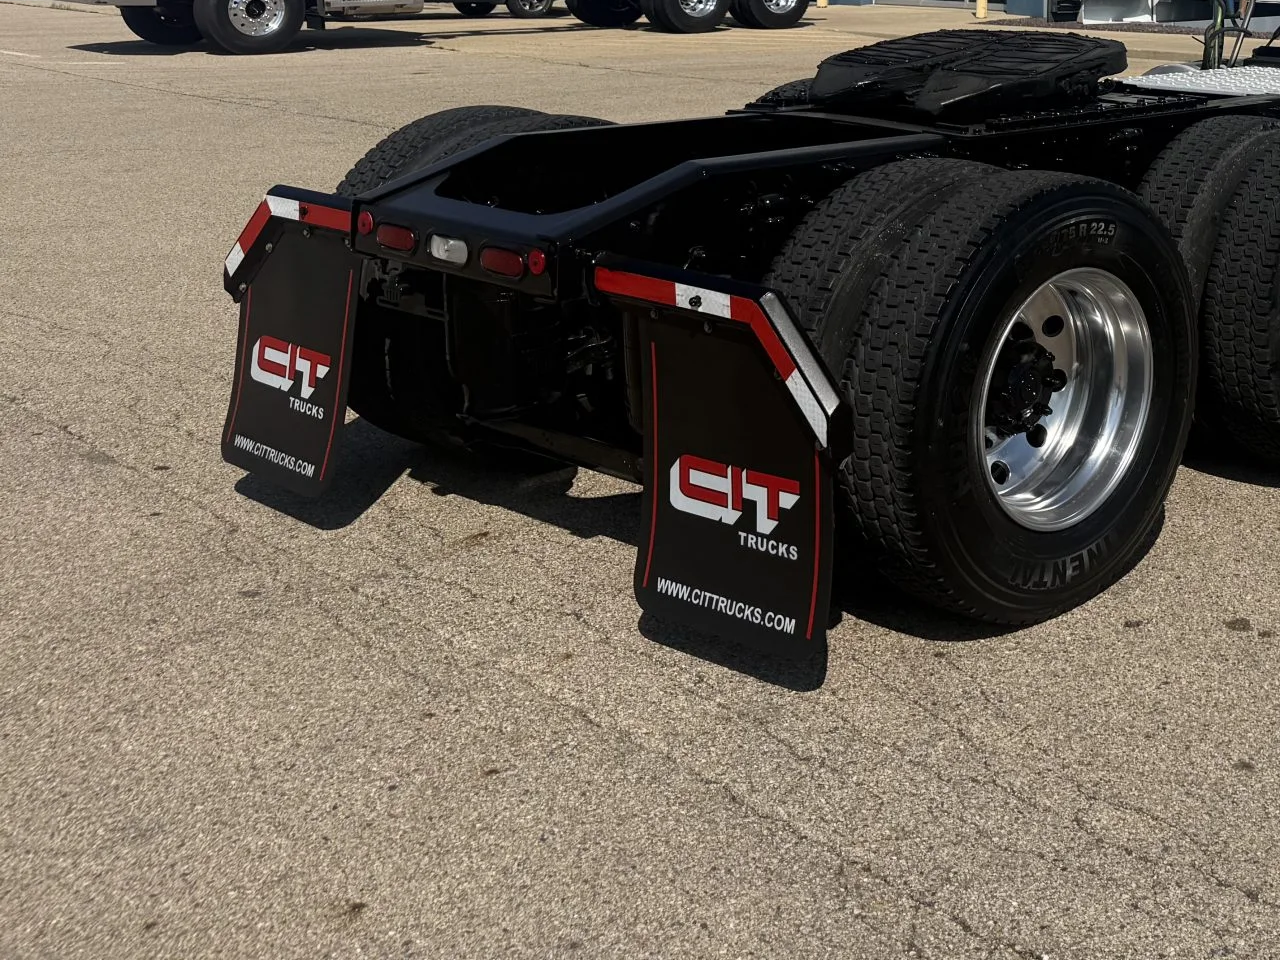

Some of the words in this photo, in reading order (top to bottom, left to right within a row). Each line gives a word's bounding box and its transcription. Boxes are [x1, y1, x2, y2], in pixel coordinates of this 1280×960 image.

[1089, 222, 1116, 236] 22.5
[250, 335, 331, 399] CIT
[289, 396, 324, 420] TRUCKS
[234, 434, 315, 478] WWW.CITTRUCKS.COM
[669, 454, 800, 535] CIT
[738, 531, 798, 560] TRUCKS
[657, 577, 796, 635] WWW.CITTRUCKS.COM
